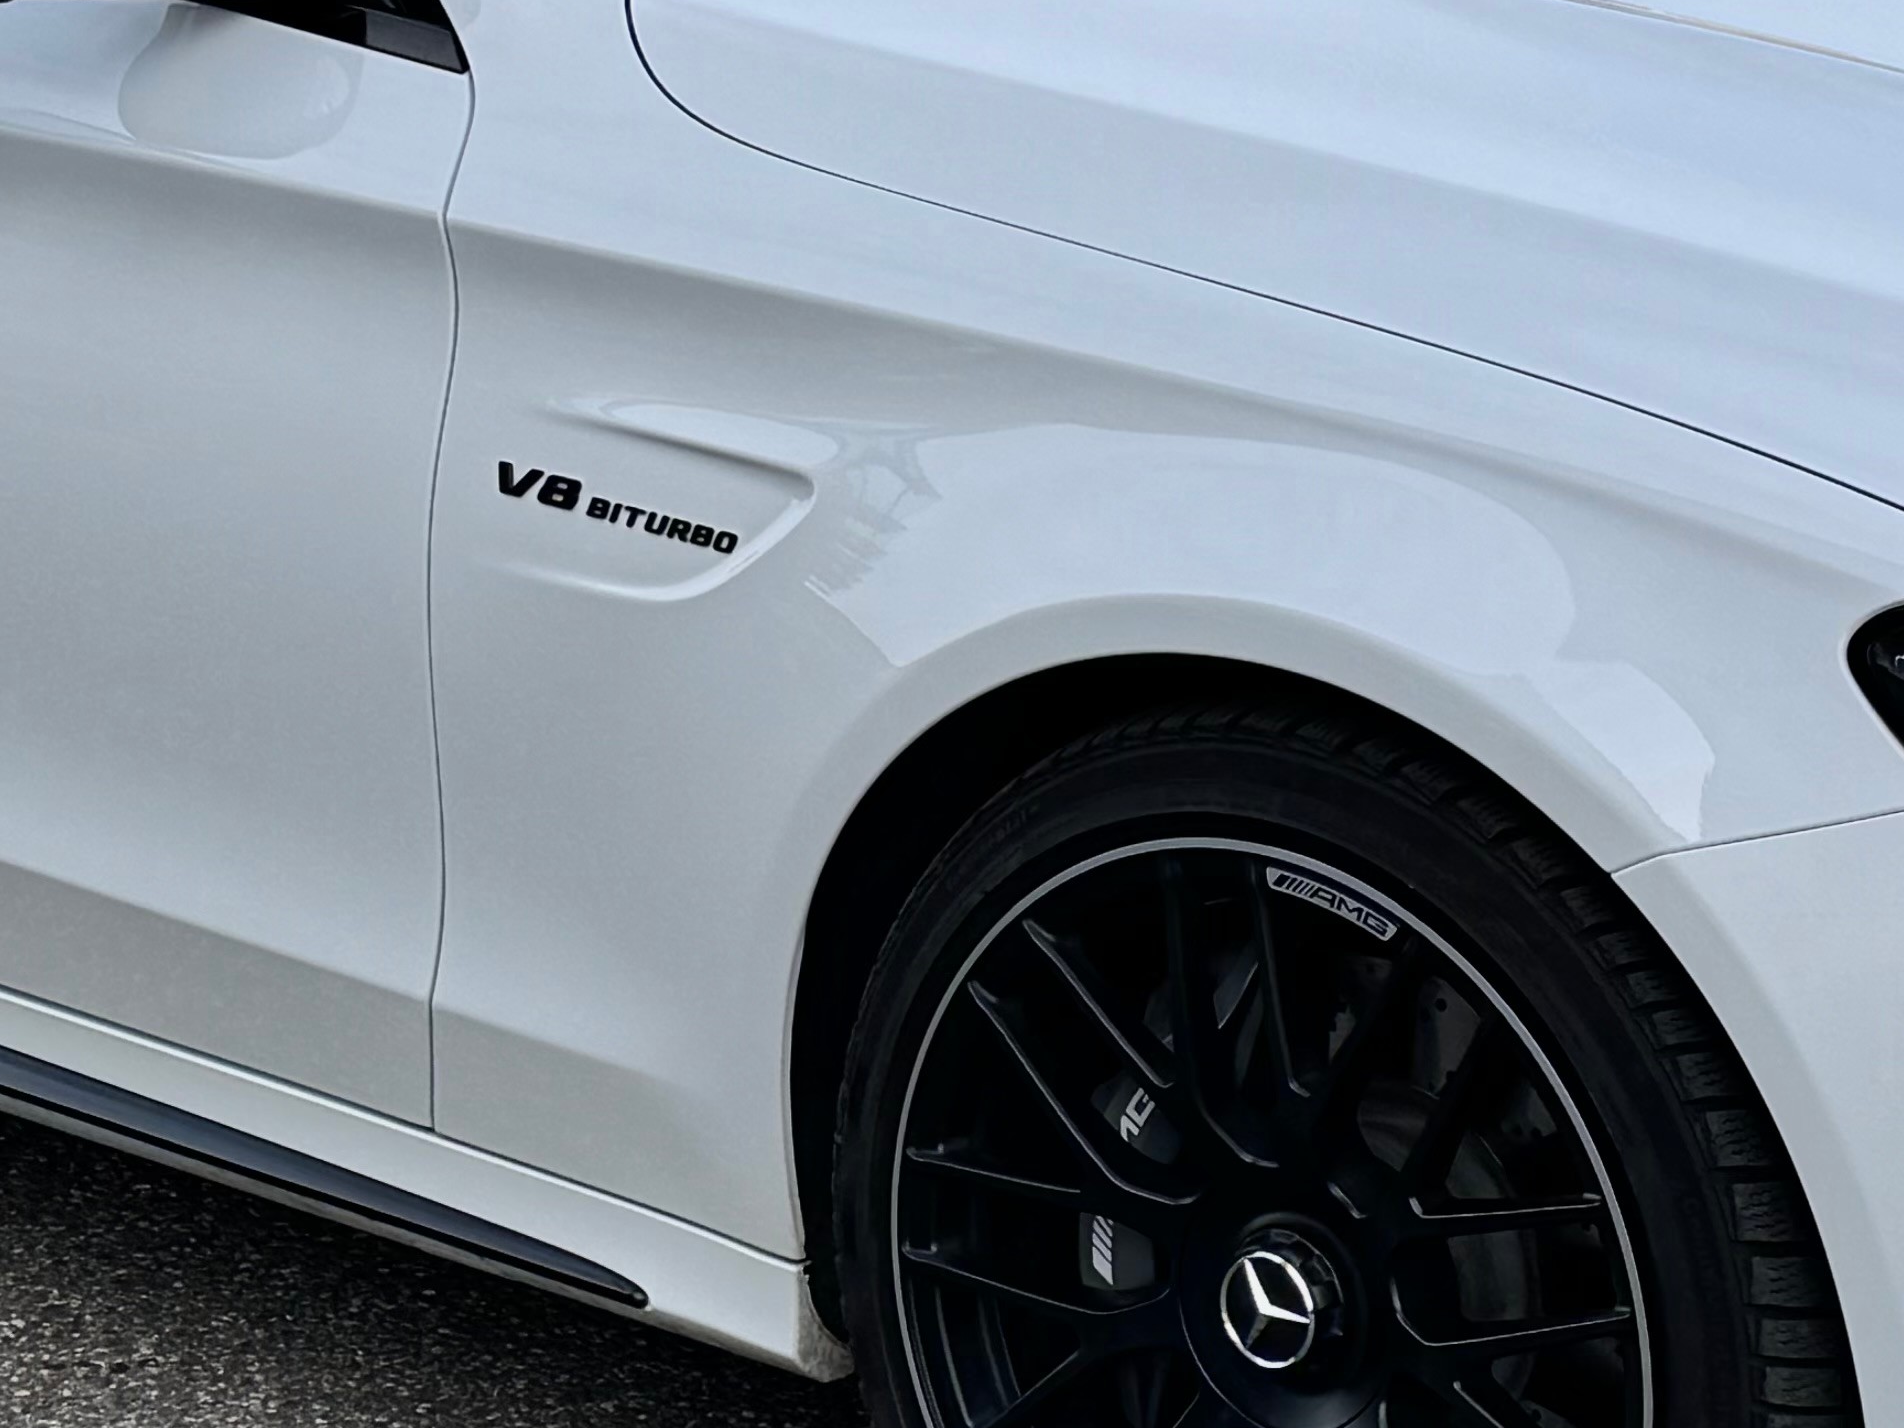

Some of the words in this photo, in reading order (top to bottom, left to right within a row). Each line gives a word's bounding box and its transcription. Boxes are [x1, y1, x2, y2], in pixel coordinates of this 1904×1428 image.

[498, 460, 583, 511] V8
[585, 496, 739, 555] BITURBO
[1308, 886, 1390, 938] AMG
